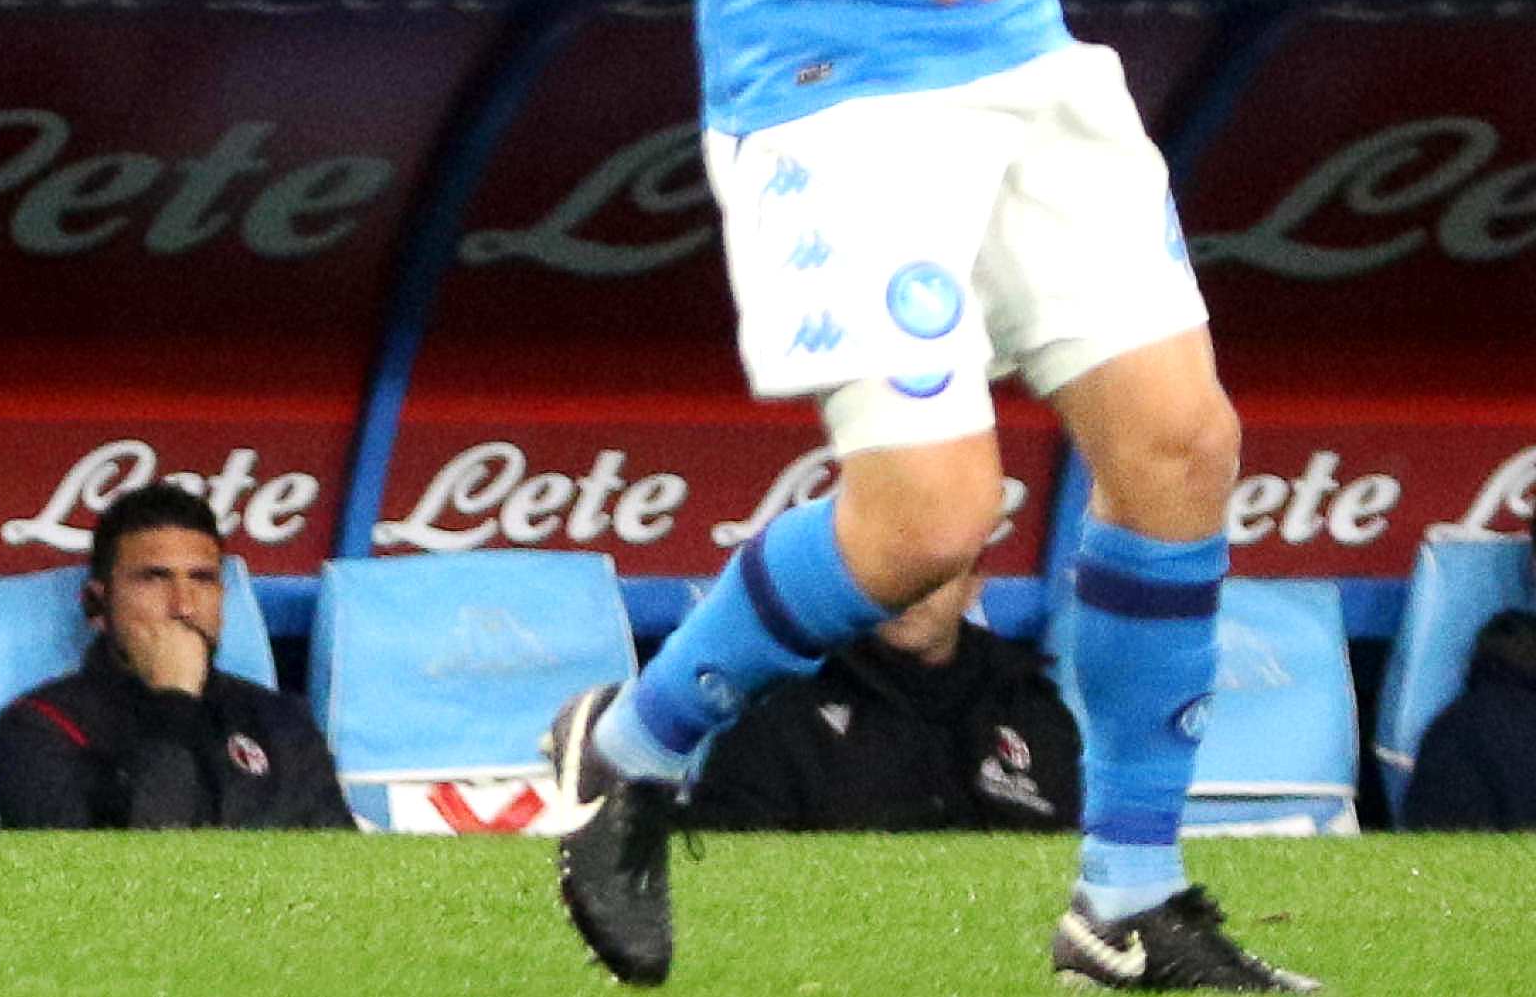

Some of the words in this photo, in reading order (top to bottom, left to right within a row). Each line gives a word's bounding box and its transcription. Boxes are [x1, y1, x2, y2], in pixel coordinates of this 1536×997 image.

[1189, 116, 1536, 281] Le
[0, 438, 321, 553] Lte
[371, 441, 690, 551] Lete
[1226, 450, 1402, 546] ete
